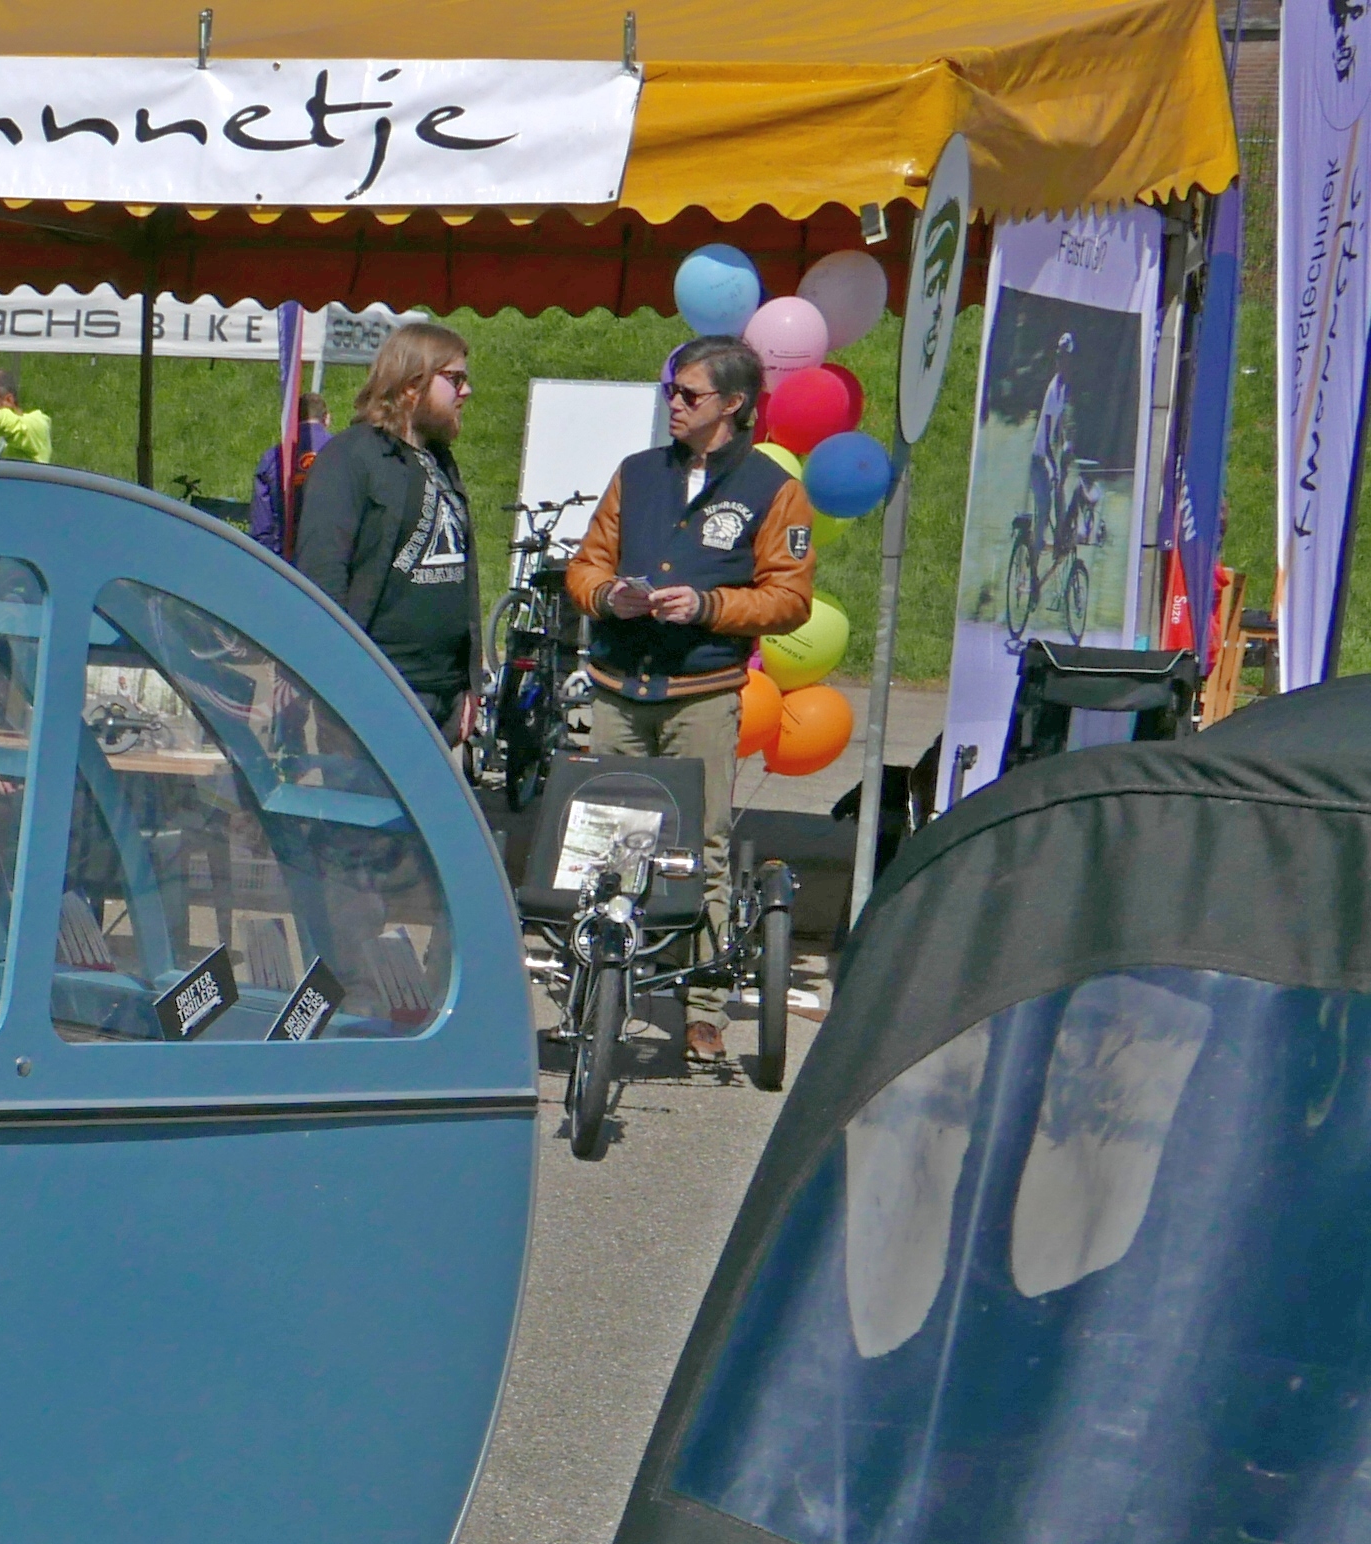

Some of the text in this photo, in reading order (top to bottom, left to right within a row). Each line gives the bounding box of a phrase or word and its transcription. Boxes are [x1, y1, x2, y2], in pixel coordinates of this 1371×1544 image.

[1170, 594, 1188, 625] Suze
[175, 970, 214, 1010] DRIFTER
[176, 981, 220, 1023] TRAILERS
